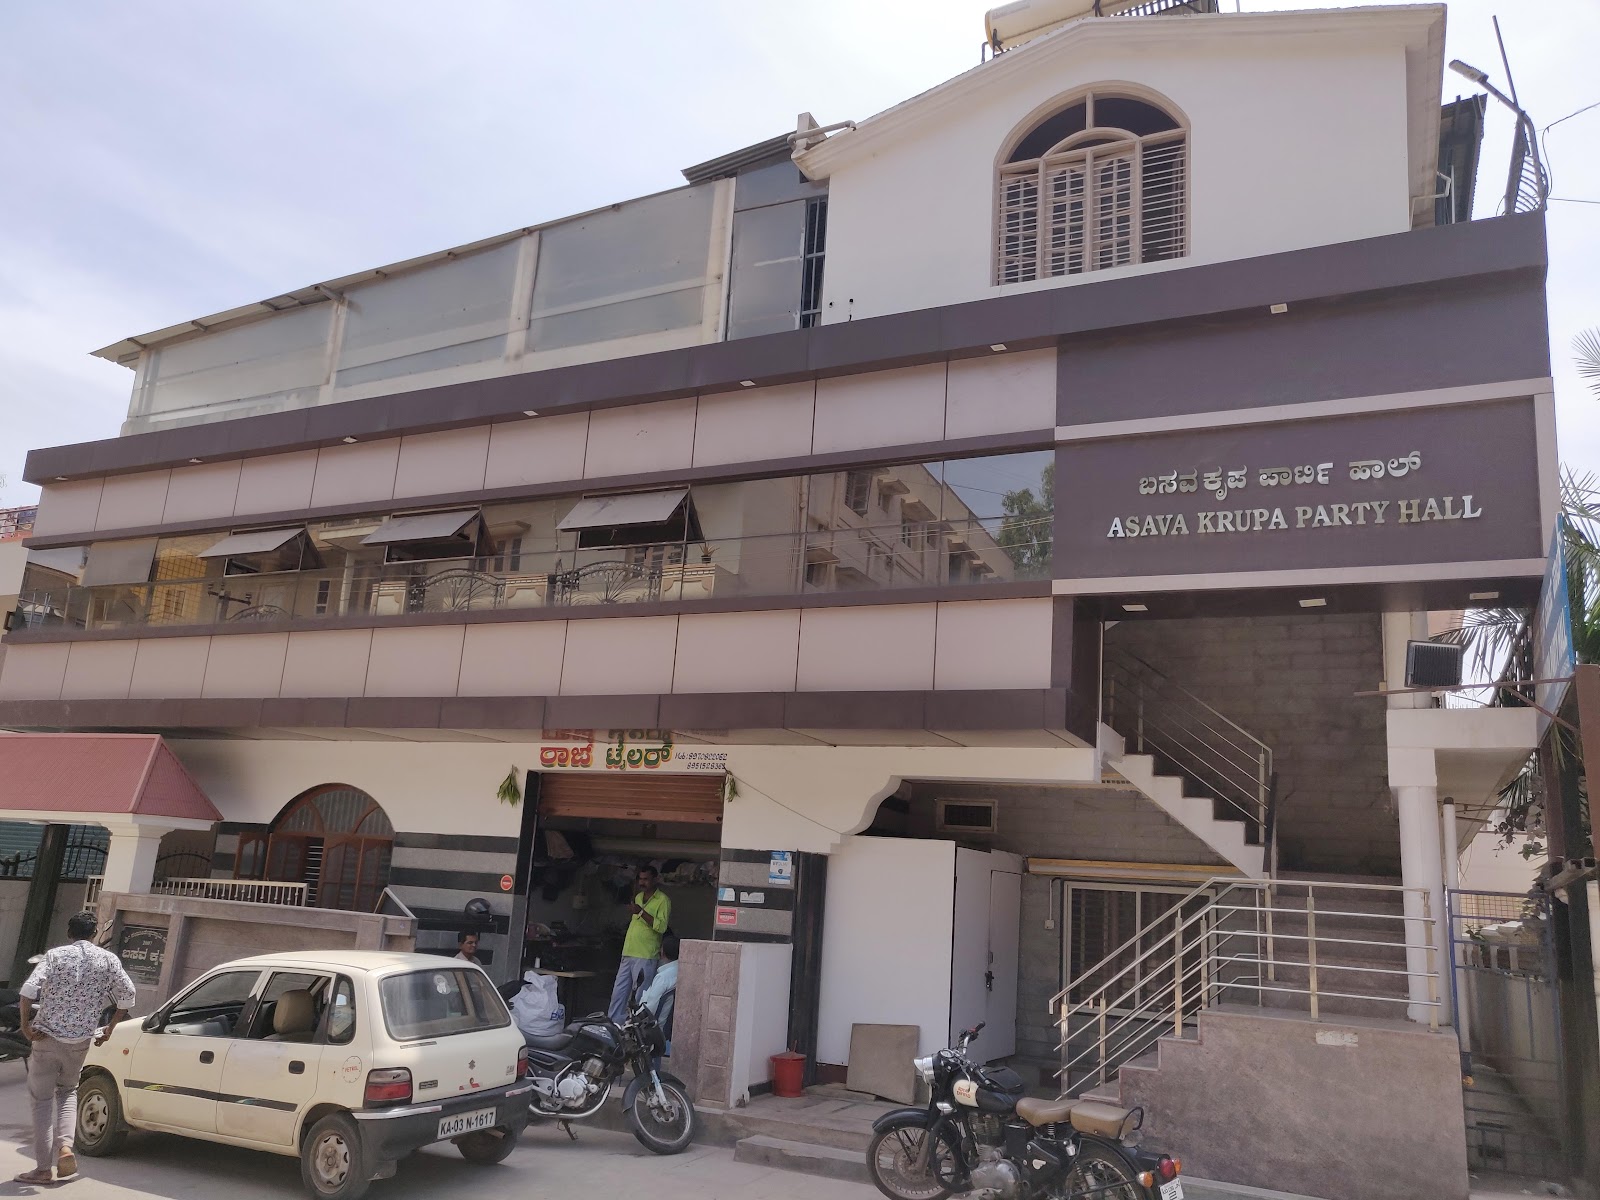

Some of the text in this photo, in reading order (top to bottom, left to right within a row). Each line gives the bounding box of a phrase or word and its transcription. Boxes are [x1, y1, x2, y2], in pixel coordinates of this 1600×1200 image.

[1139, 469, 1198, 495] ಬಸವ
[1348, 450, 1422, 480] ಹಾಲ್
[1107, 494, 1482, 539] ASAVA KRUPA PARTY HALL
[440, 1112, 494, 1136] KA-03 N-1617
